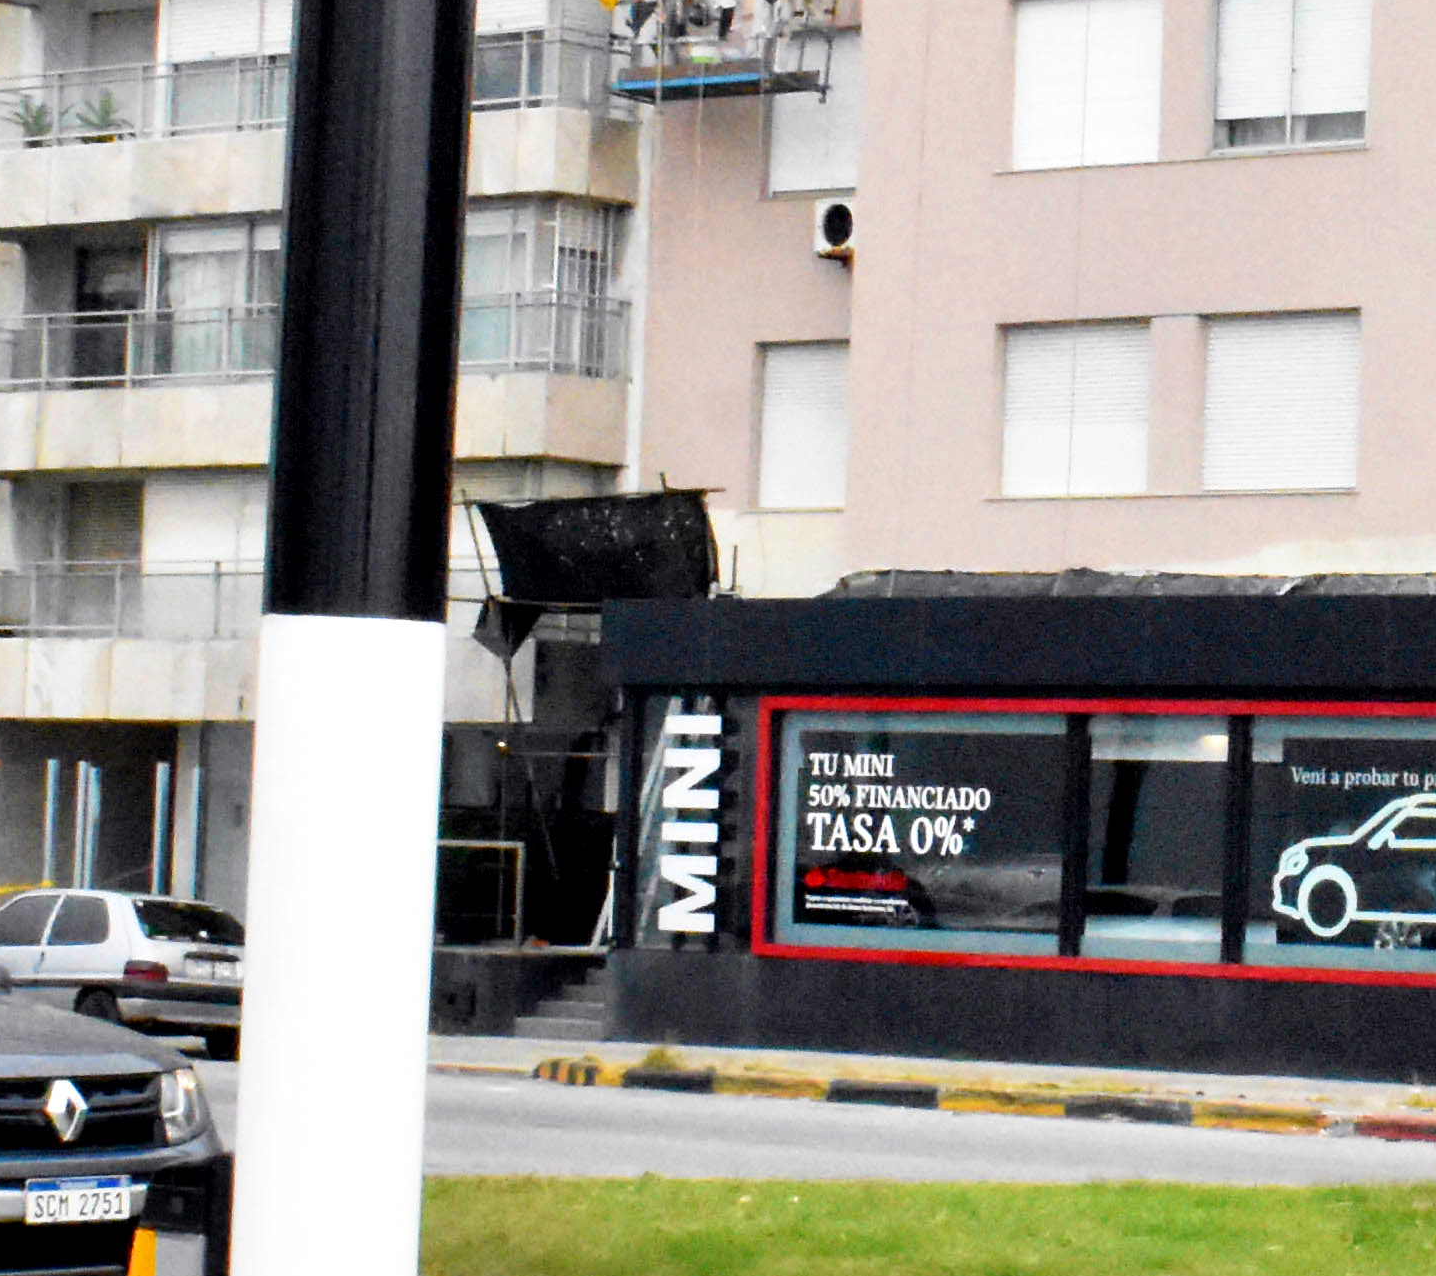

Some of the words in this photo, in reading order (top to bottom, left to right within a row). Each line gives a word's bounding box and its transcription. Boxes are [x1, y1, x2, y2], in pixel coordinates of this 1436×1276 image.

[809, 752, 838, 776] TU
[843, 753, 894, 777] MINI
[1331, 771, 1340, 786] a
[1344, 767, 1398, 790] probar
[1403, 771, 1419, 787] tu
[808, 784, 851, 808] 50%
[854, 785, 991, 811] FINANCIADO
[658, 714, 722, 933] MINI
[807, 812, 900, 853] TASA
[34, 1194, 69, 1218] SCM
[79, 1192, 124, 1216] 2751
